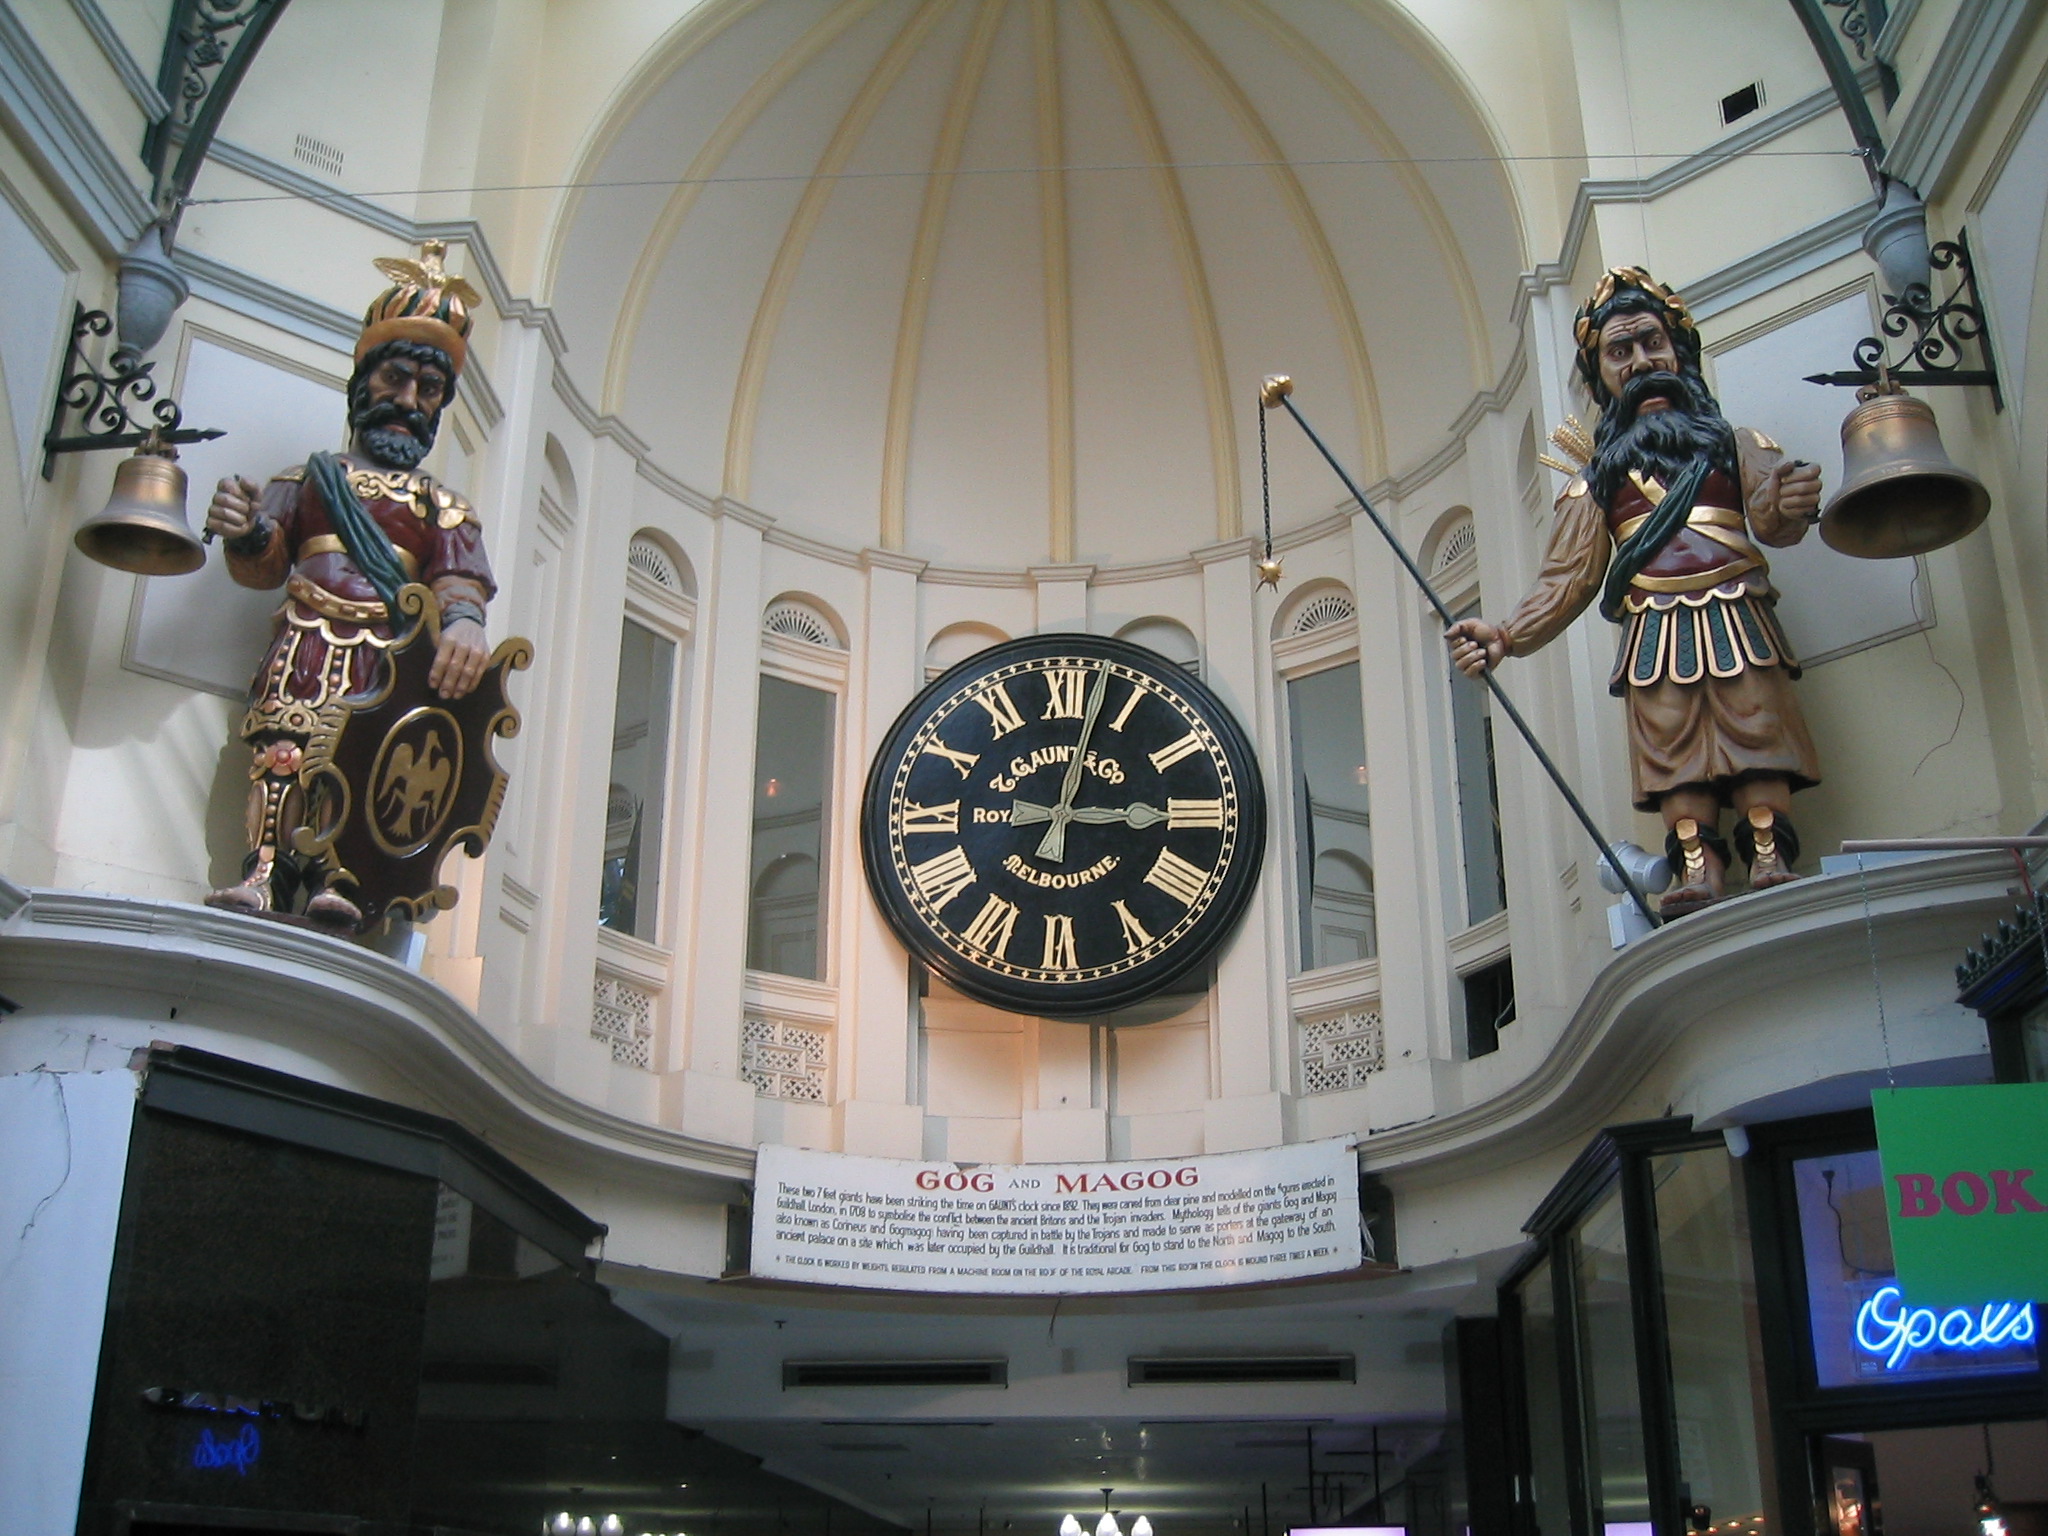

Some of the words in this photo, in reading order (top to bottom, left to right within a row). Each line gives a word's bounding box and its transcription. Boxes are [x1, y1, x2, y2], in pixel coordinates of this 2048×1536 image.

[972, 681, 1027, 741] XI
[1040, 669, 1087, 719] XII
[1109, 684, 1147, 733] I
[923, 732, 981, 781] X
[1148, 730, 1205, 773] II
[903, 798, 961, 834] IX
[973, 807, 1013, 823] ROY
[1166, 797, 1224, 831] III
[911, 845, 977, 914] VIII
[1143, 846, 1211, 908] IIII
[961, 893, 1020, 961] VII
[1040, 914, 1079, 970] VI
[1111, 900, 1155, 954] V
[778, 1182, 800, 1196] These
[802, 1186, 815, 1198] two
[823, 1187, 836, 1200] feet
[838, 1189, 862, 1205] giants
[865, 1191, 882, 1204] have
[885, 1193, 904, 1206] been
[907, 1195, 938, 1213] striking
[940, 1197, 954, 1209] the
[956, 1198, 974, 1210] time
[975, 1202, 987, 1210] on
[1018, 1199, 1038, 1211] clock
[1040, 1200, 1060, 1211] since
[1082, 1199, 1100, 1215] They
[1101, 1201, 1118, 1210] were
[1119, 1197, 1142, 1209] carved
[1144, 1196, 1160, 1208] from
[1183, 1193, 1199, 1208] pine
[1201, 1191, 1216, 1204] and
[1217, 1187, 1251, 1202] modelled
[1252, 1189, 1263, 1198] on
[1264, 1184, 1275, 1196] the
[1277, 1182, 1300, 1198] fgures
[1301, 1175, 1326, 1191] erected
[1327, 1174, 1335, 1186] in
[915, 1170, 994, 1193] GOG
[1008, 1178, 1041, 1189] AND
[1055, 1167, 1198, 1194] MAGOG
[776, 1213, 791, 1225] also
[794, 1214, 818, 1228] known
[820, 1221, 830, 1230] as
[832, 1218, 866, 1233] Corineus
[869, 1223, 885, 1234] and
[936, 1226, 964, 1244] having
[968, 1228, 988, 1240] been
[991, 1229, 1027, 1243] captured
[1030, 1229, 1038, 1240] in
[1040, 1229, 1062, 1240] battle
[1064, 1229, 1075, 1245] by
[1077, 1228, 1090, 1240] the
[1091, 1228, 1120, 1244] Trojans
[1123, 1226, 1139, 1238] and
[1142, 1225, 1166, 1237] made
[1168, 1225, 1176, 1235] to
[1179, 1225, 1200, 1235] serve
[1204, 1223, 1214, 1232] as
[1216, 1219, 1243, 1234] porters
[1245, 1217, 1254, 1228] at
[1255, 1214, 1269, 1227] the
[1271, 1212, 1305, 1230] gateway
[1308, 1207, 1318, 1219] of
[1321, 1207, 1333, 1217] an
[839, 1204, 847, 1216] in
[849, 1205, 865, 1218] 1708
[868, 1208, 875, 1219] to
[877, 1208, 915, 1224] symbolise
[918, 1211, 930, 1222] the
[933, 1212, 962, 1224] conflict
[965, 1213, 995, 1225] between
[996, 1214, 1008, 1225] the
[1010, 1214, 1037, 1226] ancient
[1040, 1214, 1066, 1226] Britons
[1068, 1214, 1084, 1225] and
[1086, 1213, 1100, 1225] the
[1103, 1213, 1126, 1229] Trojan
[1172, 1207, 1213, 1225] Mythology
[1216, 1204, 1230, 1217] tells
[1232, 1203, 1241, 1215] of
[1242, 1201, 1255, 1214] the
[1257, 1199, 1281, 1217] giants
[1283, 1196, 1298, 1212] Gog
[1300, 1192, 1314, 1206] and
[775, 1229, 804, 1242] ancient
[807, 1232, 834, 1245] palace
[836, 1237, 848, 1246] on
[858, 1236, 872, 1249] site
[875, 1238, 903, 1251] which
[907, 1243, 924, 1252] was
[927, 1241, 945, 1253] later
[947, 1243, 985, 1257] occupied
[988, 1243, 1000, 1260] by
[1002, 1243, 1016, 1255] the
[1062, 1243, 1068, 1255] It
[1069, 1243, 1076, 1255] is
[1077, 1242, 1116, 1254] traditional
[1119, 1241, 1130, 1253] for
[1132, 1241, 1149, 1256] Gog
[1151, 1240, 1161, 1251] to
[1163, 1237, 1184, 1250] stand
[1187, 1238, 1196, 1249] to
[1197, 1236, 1210, 1248] the
[1212, 1233, 1234, 1246] North
[1237, 1231, 1252, 1244] and
[1286, 1227, 1295, 1237] to
[1297, 1223, 1310, 1236] the
[1856, 1287, 2035, 1369] Opals
